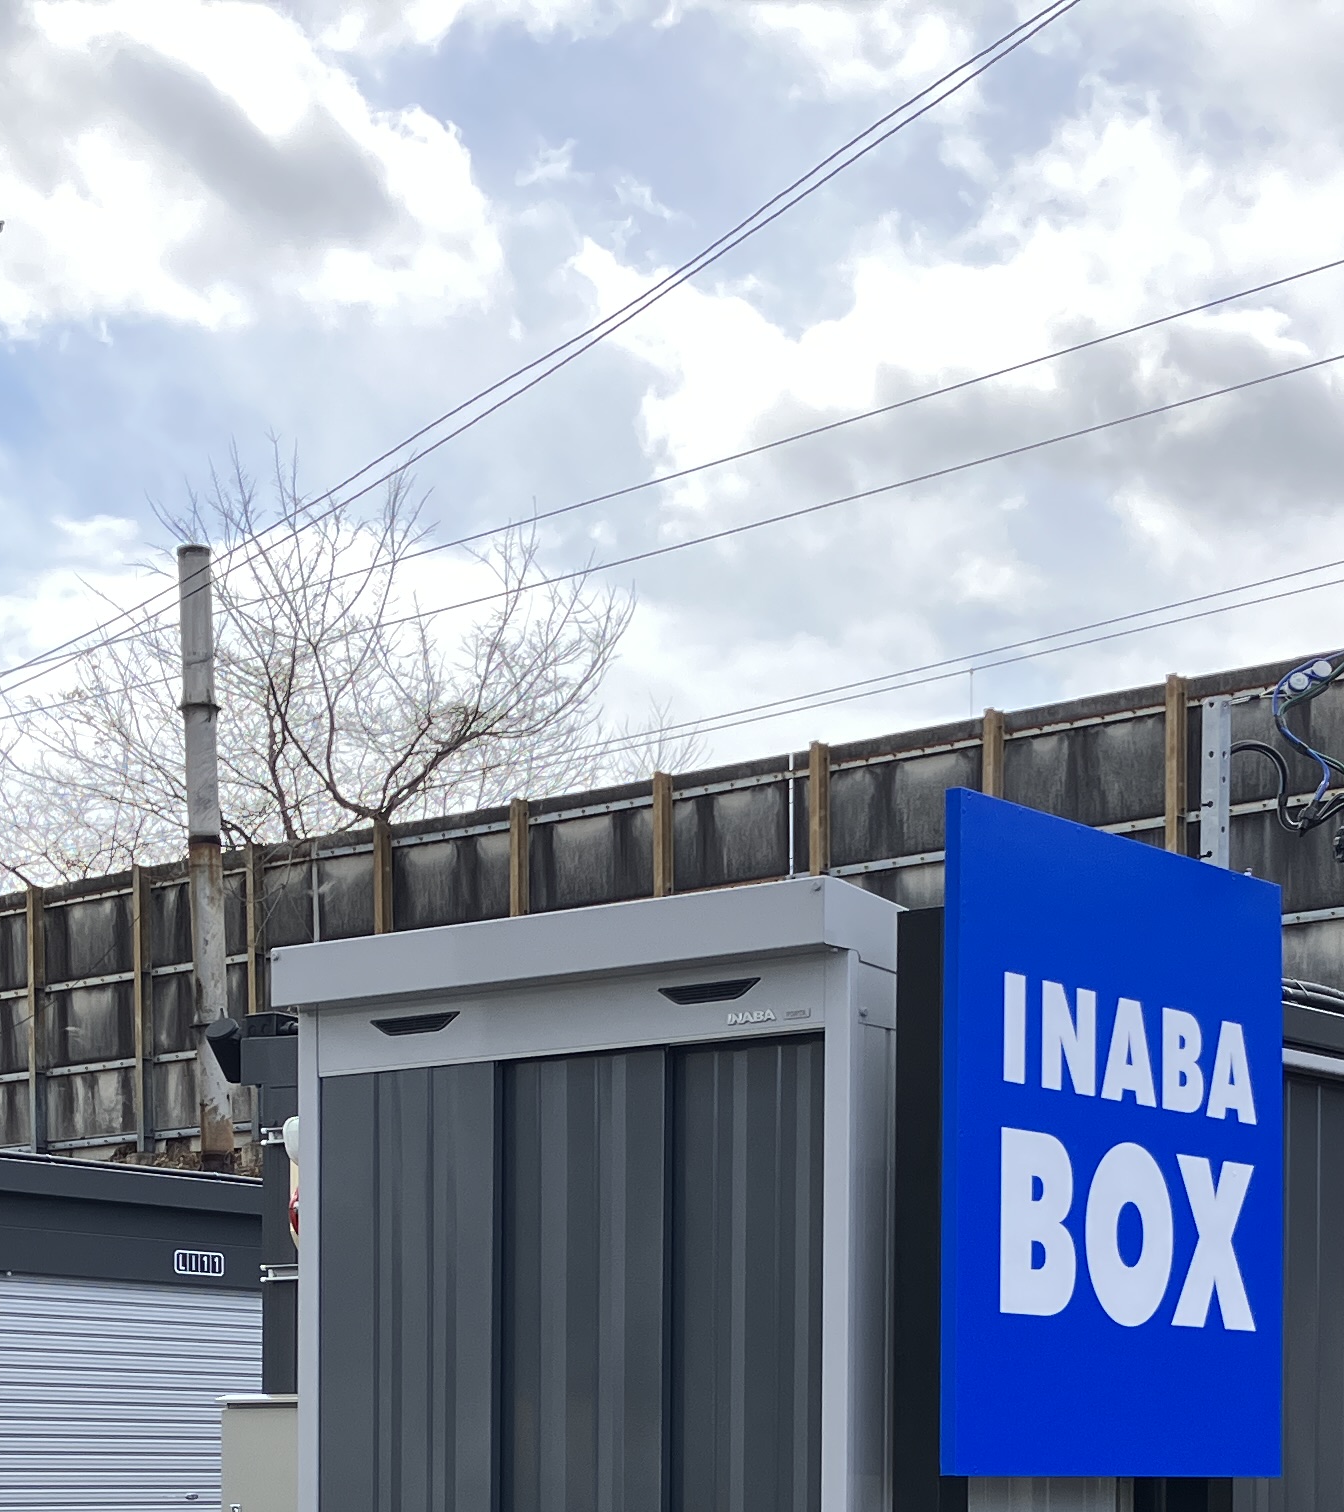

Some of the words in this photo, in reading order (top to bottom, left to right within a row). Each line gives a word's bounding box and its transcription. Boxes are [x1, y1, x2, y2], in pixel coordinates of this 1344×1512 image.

[727, 1008, 776, 1026] INABA
[1003, 971, 1258, 1126] INABA
[999, 1126, 1257, 1333] BOX
